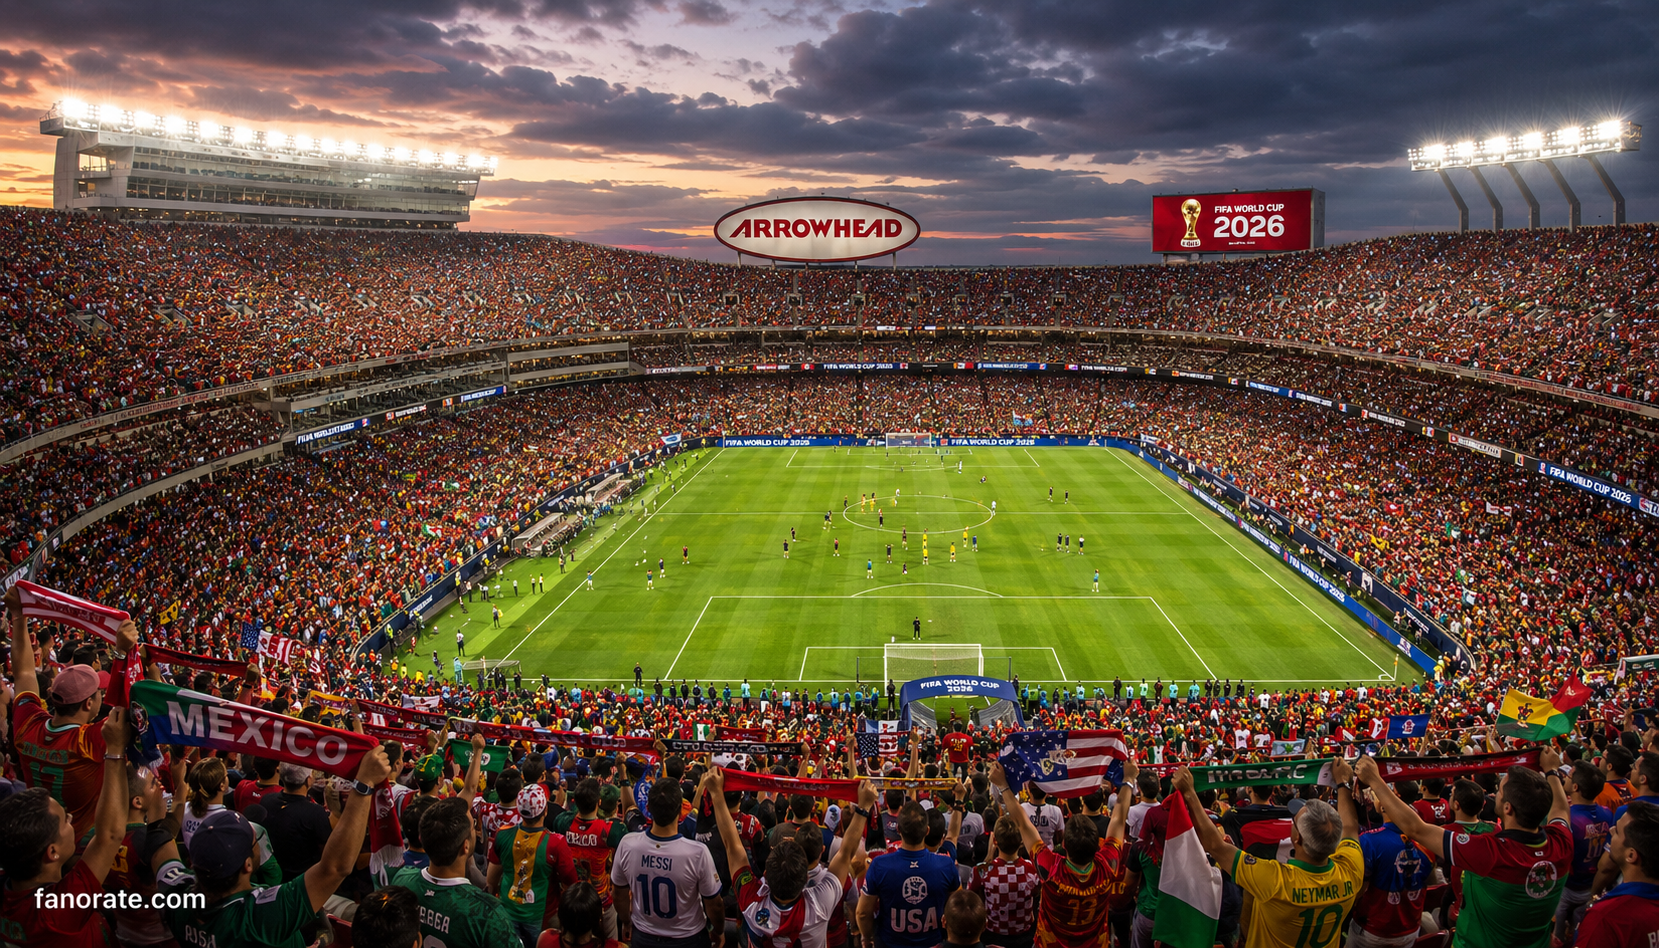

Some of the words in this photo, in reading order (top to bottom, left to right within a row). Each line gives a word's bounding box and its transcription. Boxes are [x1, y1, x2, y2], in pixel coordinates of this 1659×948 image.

[1214, 205, 1233, 213] FIFA
[1234, 204, 1265, 213] WORLD
[1266, 203, 1285, 212] CUP
[729, 219, 903, 238] ARROWHEAD
[1213, 214, 1285, 238] 2026
[969, 438, 997, 446] WORLD
[1566, 472, 1593, 489] WORLD
[1593, 482, 1611, 495] CUP
[920, 680, 942, 689] FIFA
[980, 681, 1000, 689] CUP
[166, 700, 348, 766] MEXICO
[641, 854, 673, 871] MESSI
[636, 873, 678, 919] 10
[1292, 884, 1340, 904] NEYMAR
[1342, 880, 1354, 898] JR
[890, 906, 938, 933] USA
[1295, 903, 1344, 948] 10
